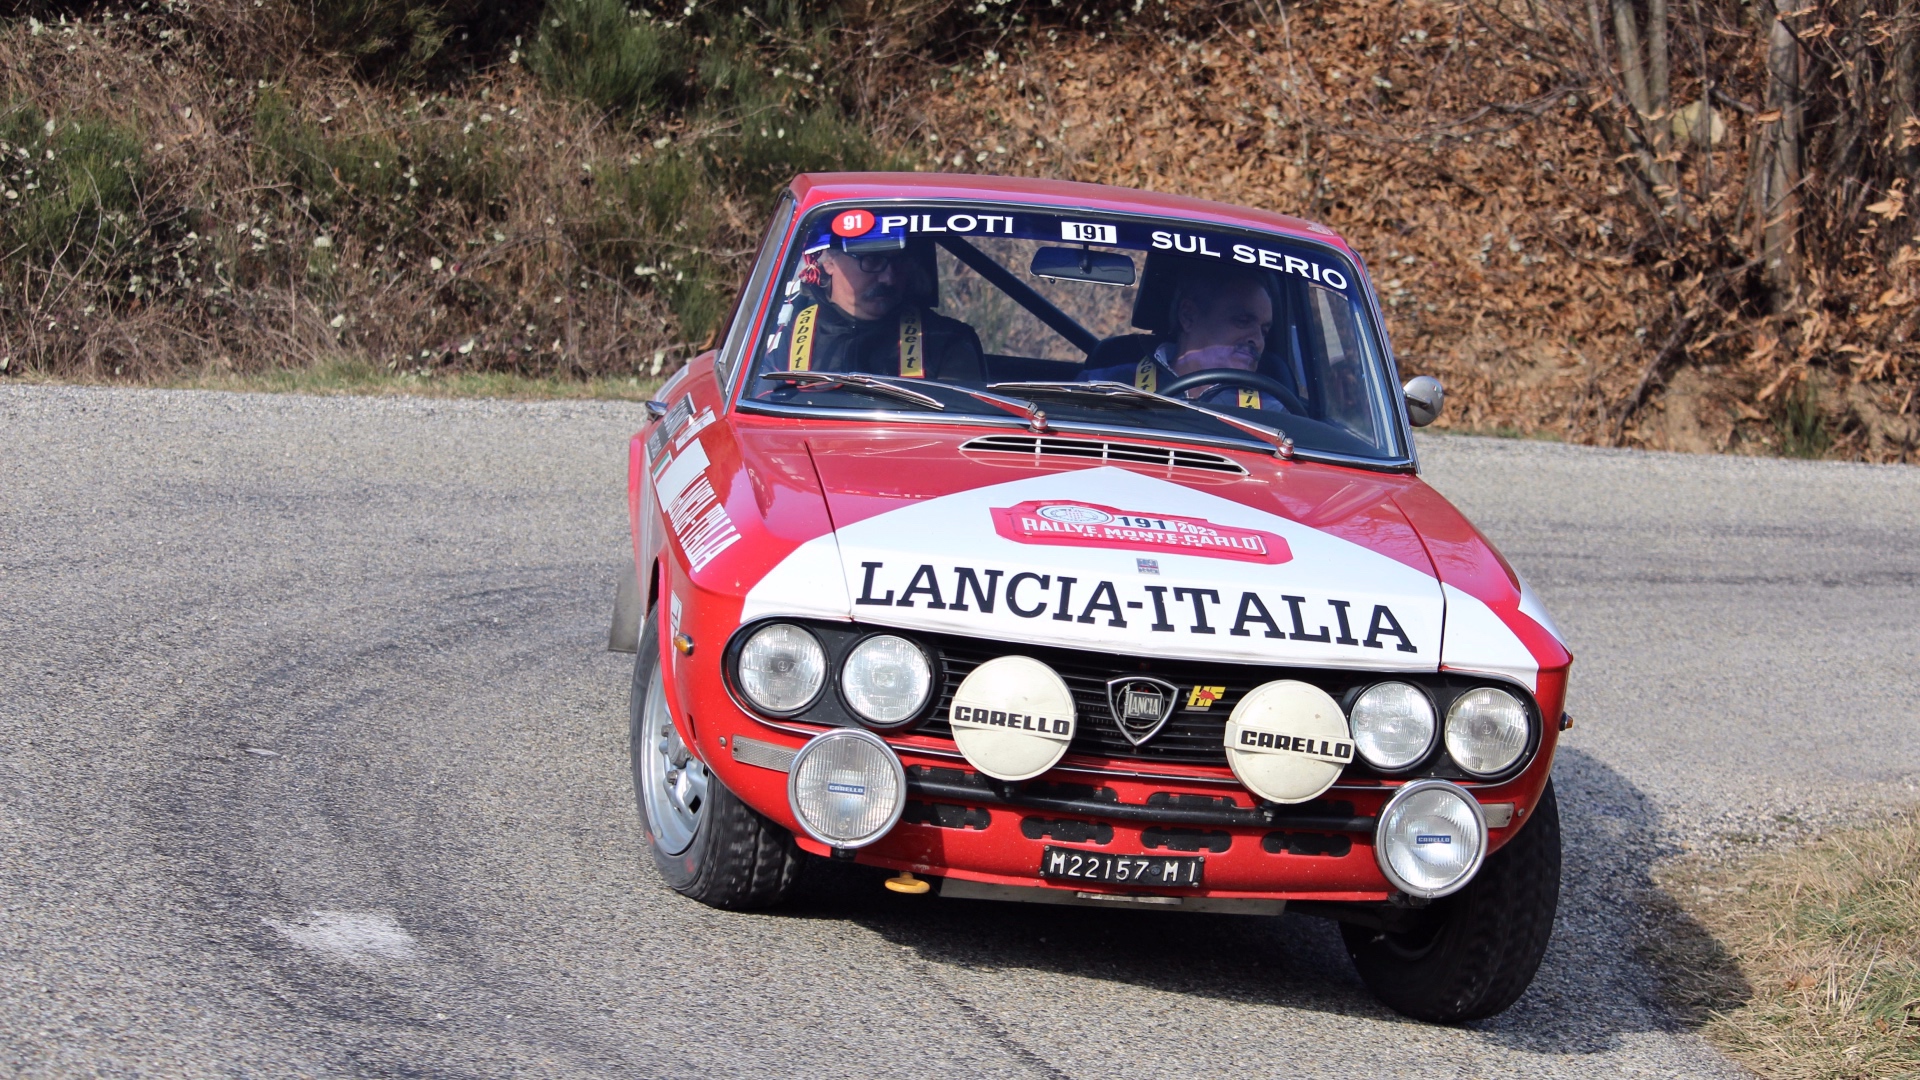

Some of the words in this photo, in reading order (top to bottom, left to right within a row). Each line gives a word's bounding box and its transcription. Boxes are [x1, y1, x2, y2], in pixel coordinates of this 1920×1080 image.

[843, 214, 862, 231] 91
[881, 214, 1014, 234] PILOTI
[1073, 224, 1106, 241] 191
[1151, 231, 1221, 258] SUL
[1232, 244, 1347, 290] SERIO
[1022, 517, 1097, 535] RALLYE
[1104, 527, 1258, 550] MONTE-CARLO
[1118, 516, 1166, 530] 191
[1178, 522, 1218, 537] 2023
[855, 562, 1418, 654] LANCIA-ITALIA
[1128, 692, 1159, 716] LANCIA
[1187, 686, 1226, 707] HF
[954, 705, 1070, 735] CARELLO
[1240, 730, 1352, 759] CARELLO
[829, 784, 864, 794] CARELLO
[1050, 852, 1150, 881] M22157
